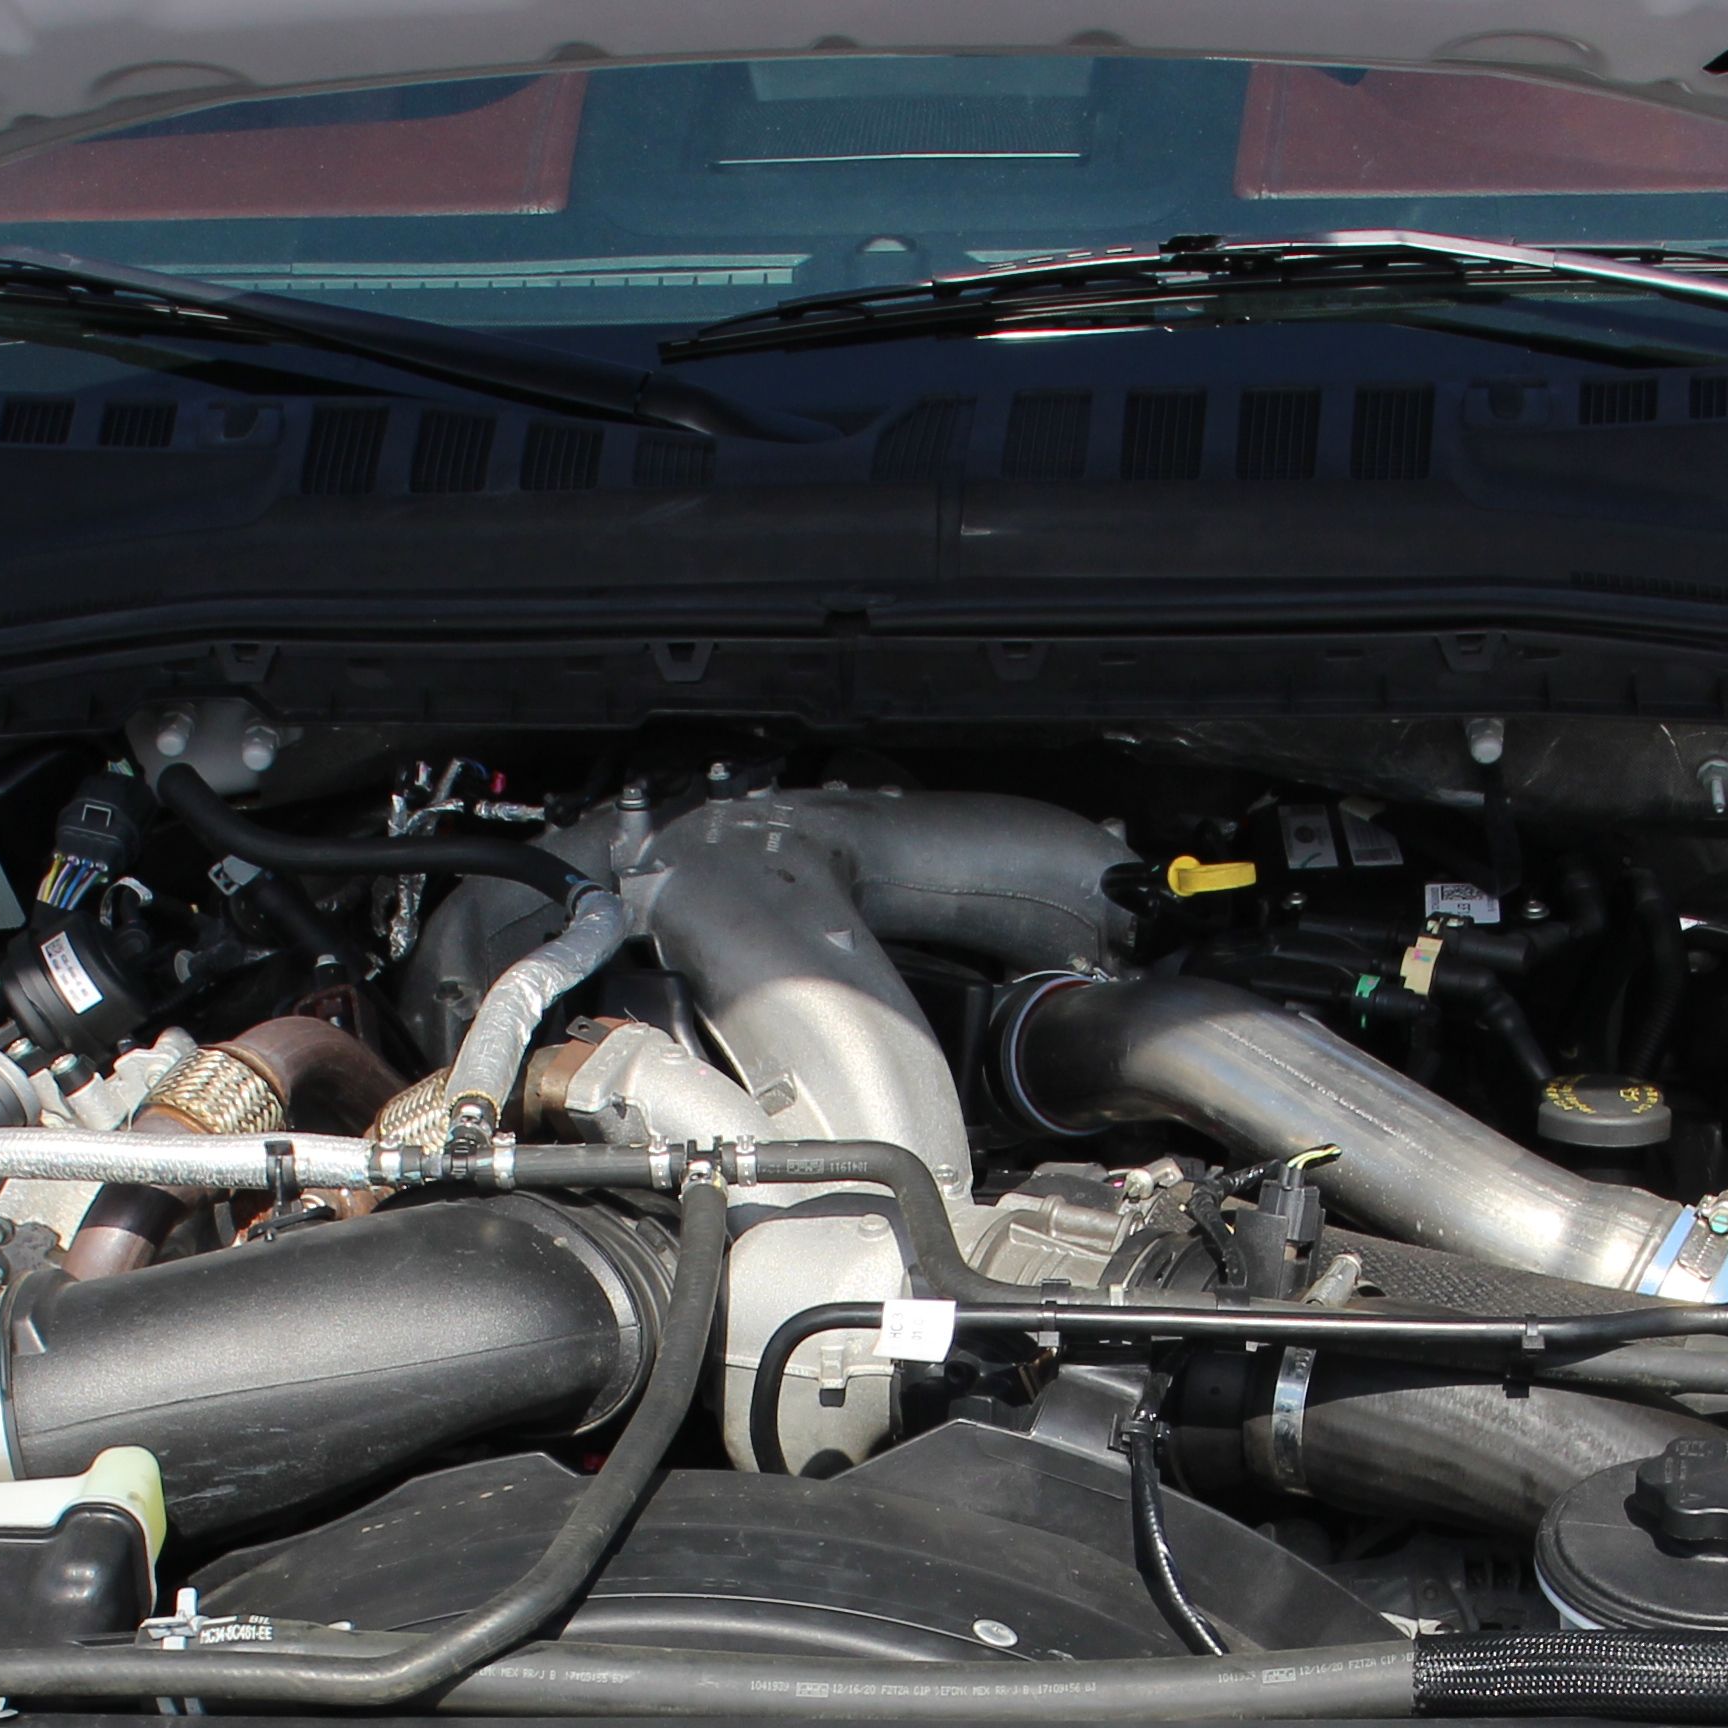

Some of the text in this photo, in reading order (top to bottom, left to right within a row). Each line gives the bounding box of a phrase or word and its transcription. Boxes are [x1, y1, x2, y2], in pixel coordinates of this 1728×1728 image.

[501, 1666, 519, 1678] MEX
[832, 1683, 877, 1695] 12/16/20
[972, 1685, 991, 1696] MEX
